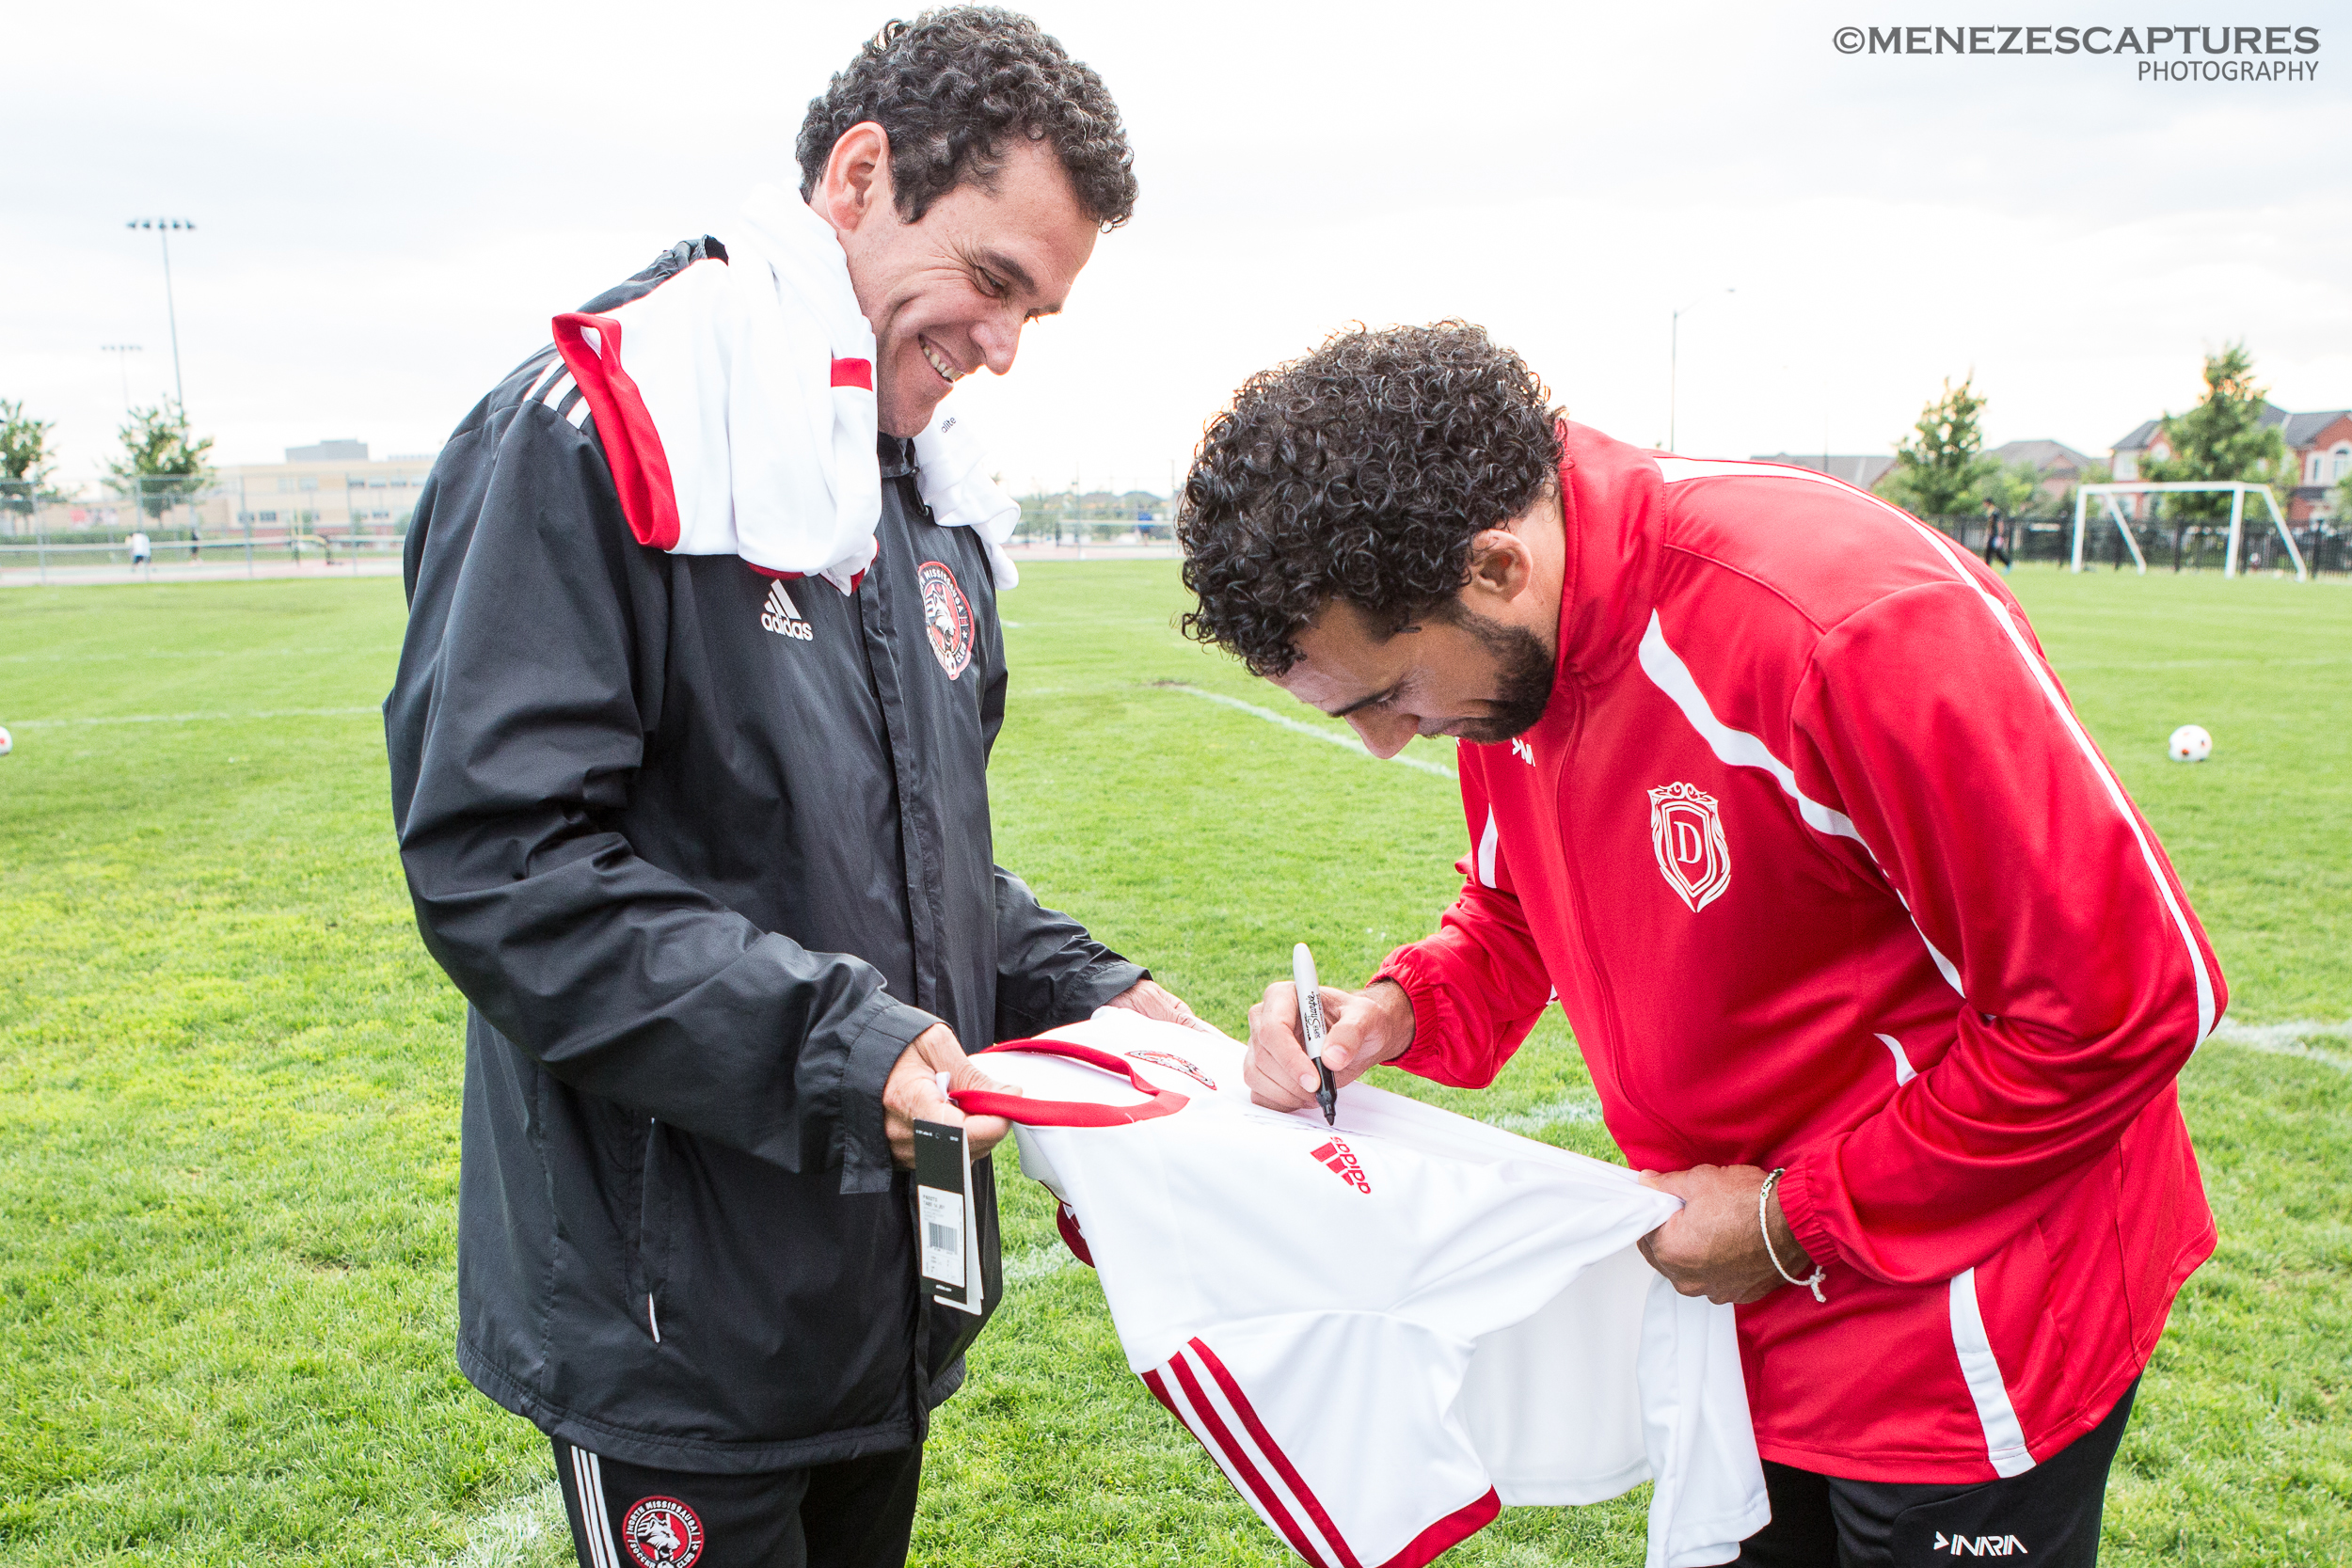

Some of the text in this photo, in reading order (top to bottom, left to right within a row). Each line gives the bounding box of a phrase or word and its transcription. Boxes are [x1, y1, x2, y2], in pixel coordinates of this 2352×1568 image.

[761, 612, 814, 641] adidas
[955, 641, 967, 664] CLUB
[1674, 821, 1702, 864] D
[1305, 994, 1321, 1028] Sharpie
[1329, 1136, 1372, 1195] adidas
[628, 1501, 698, 1531] NORTH MISSISSAUGA
[629, 1543, 695, 1568] SOCCER CLUB
[1950, 1533, 2028, 1557] INARIA
